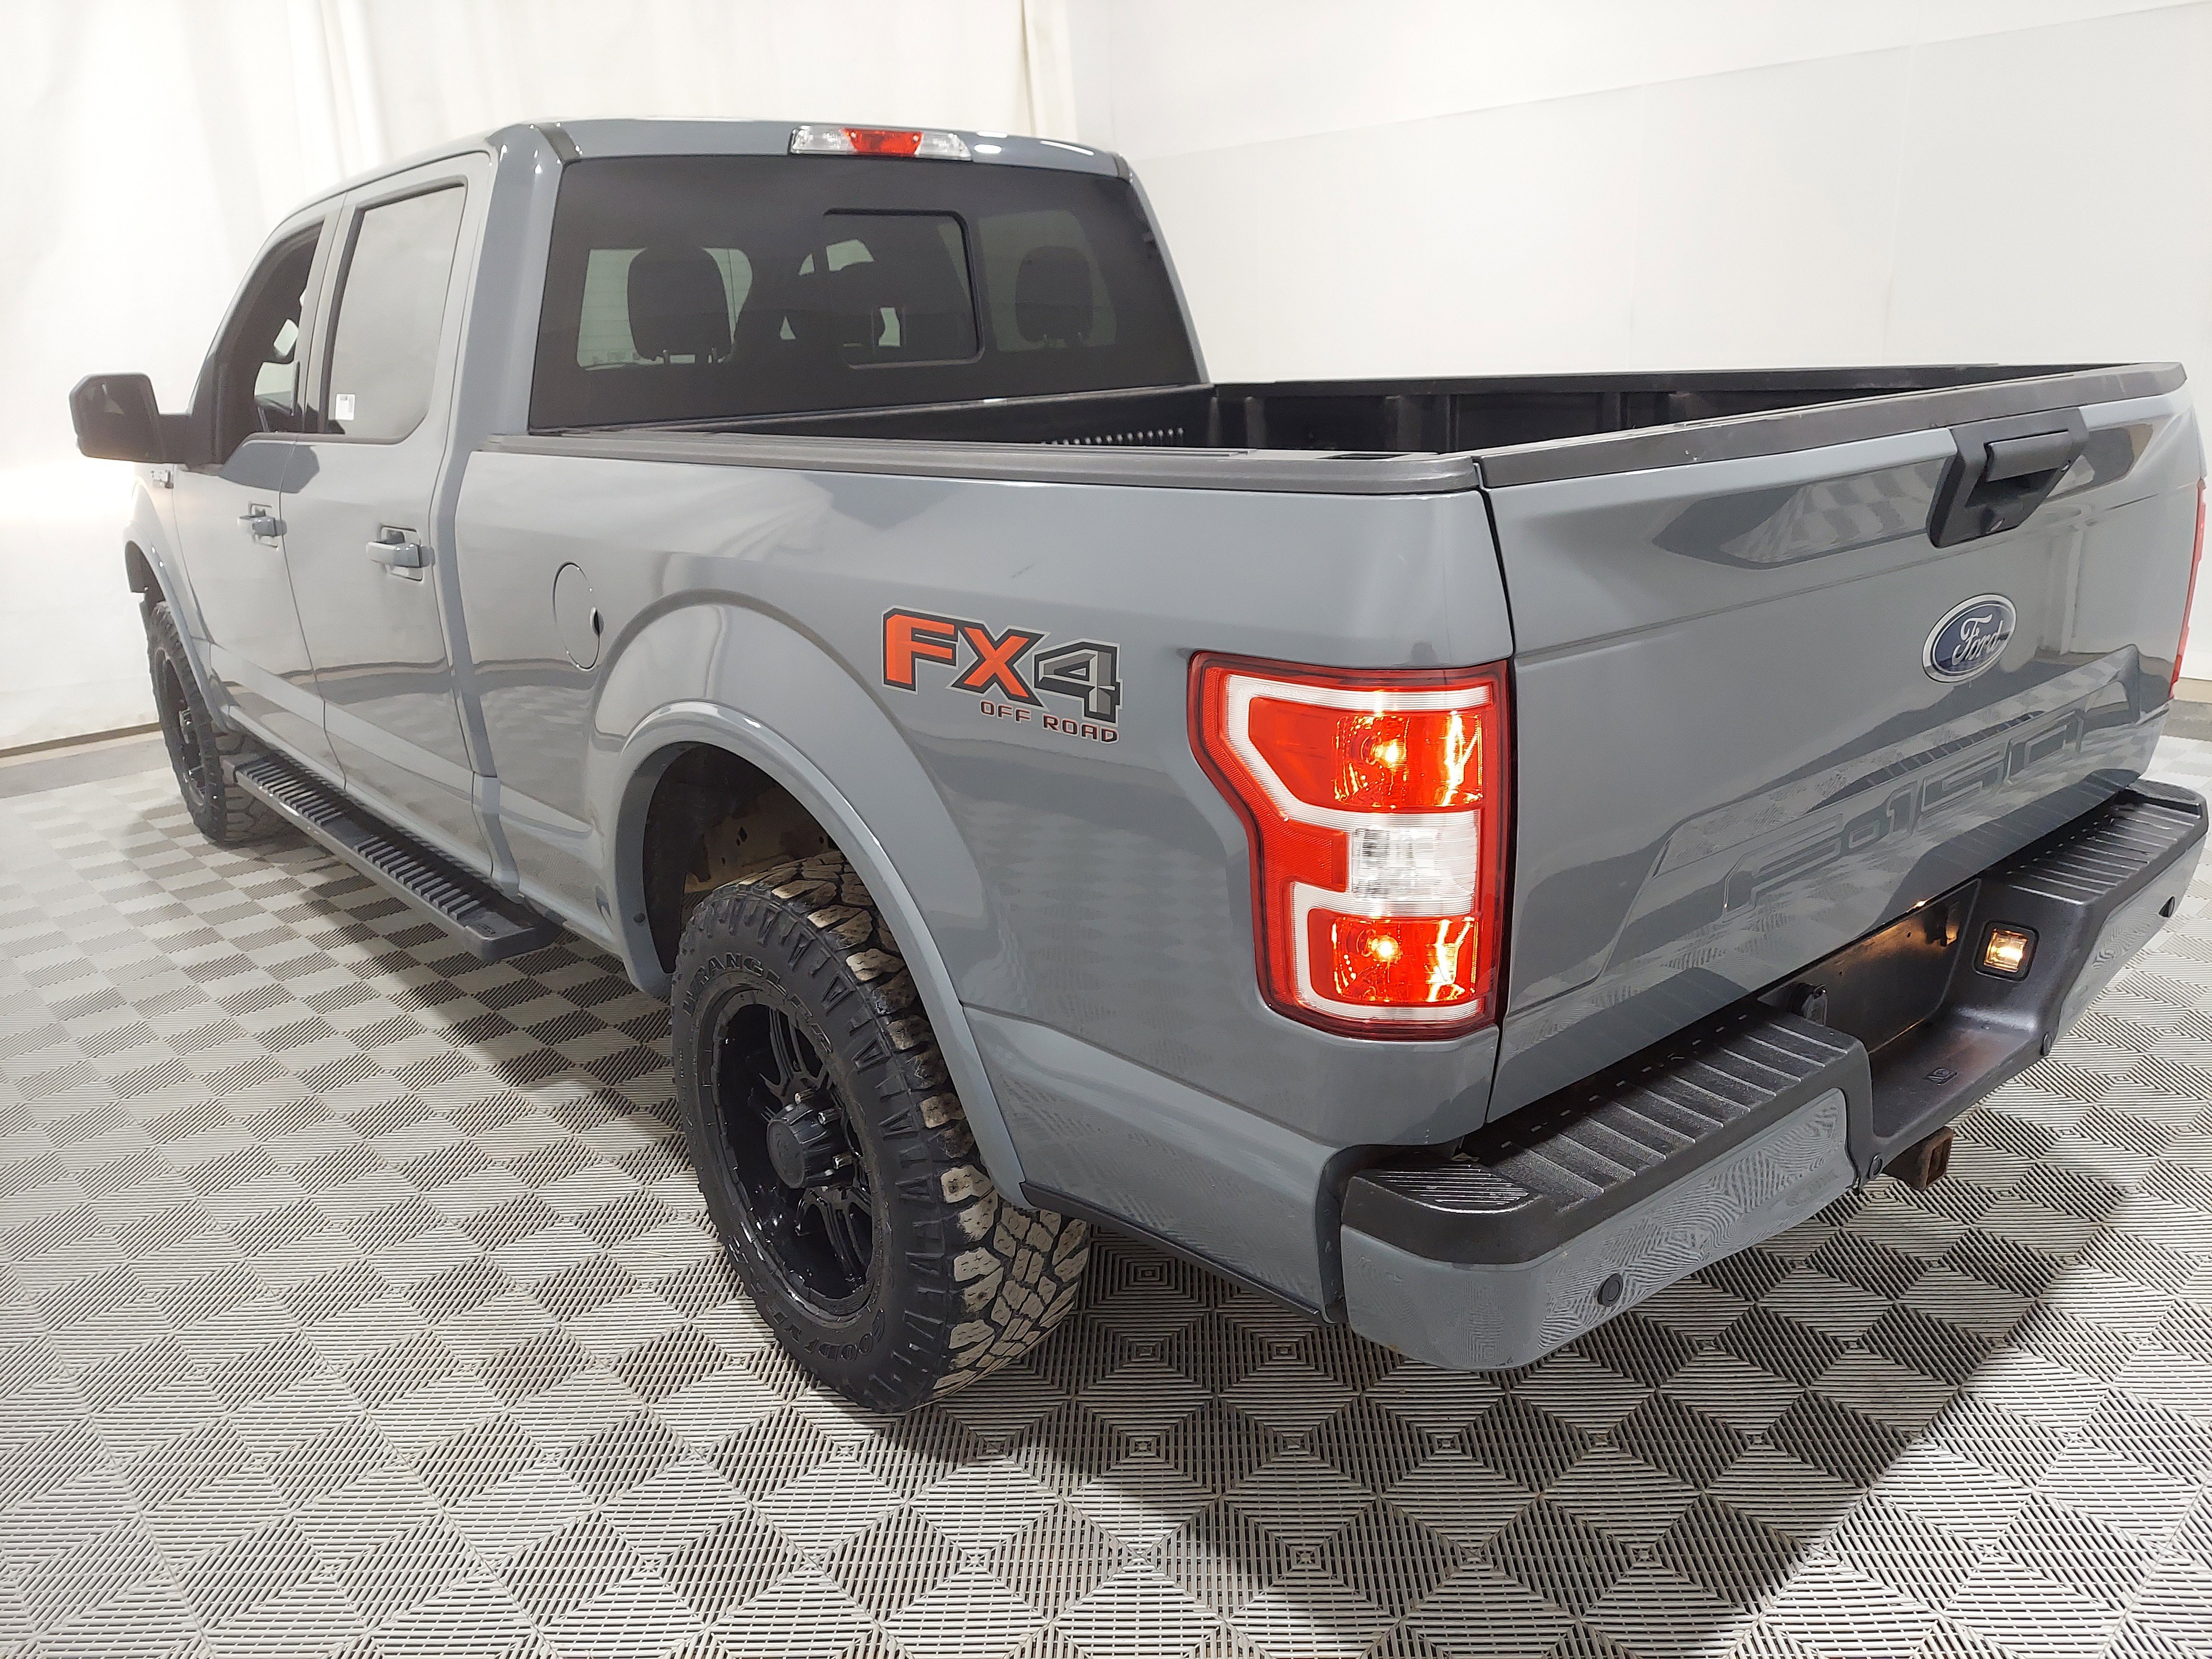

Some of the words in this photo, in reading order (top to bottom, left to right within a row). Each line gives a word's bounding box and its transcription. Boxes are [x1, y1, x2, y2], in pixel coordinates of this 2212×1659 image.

[1951, 613, 2004, 665] Ford
[882, 605, 1123, 727] FX4
[980, 699, 1032, 723] OFF
[1042, 714, 1119, 744] ROAD
